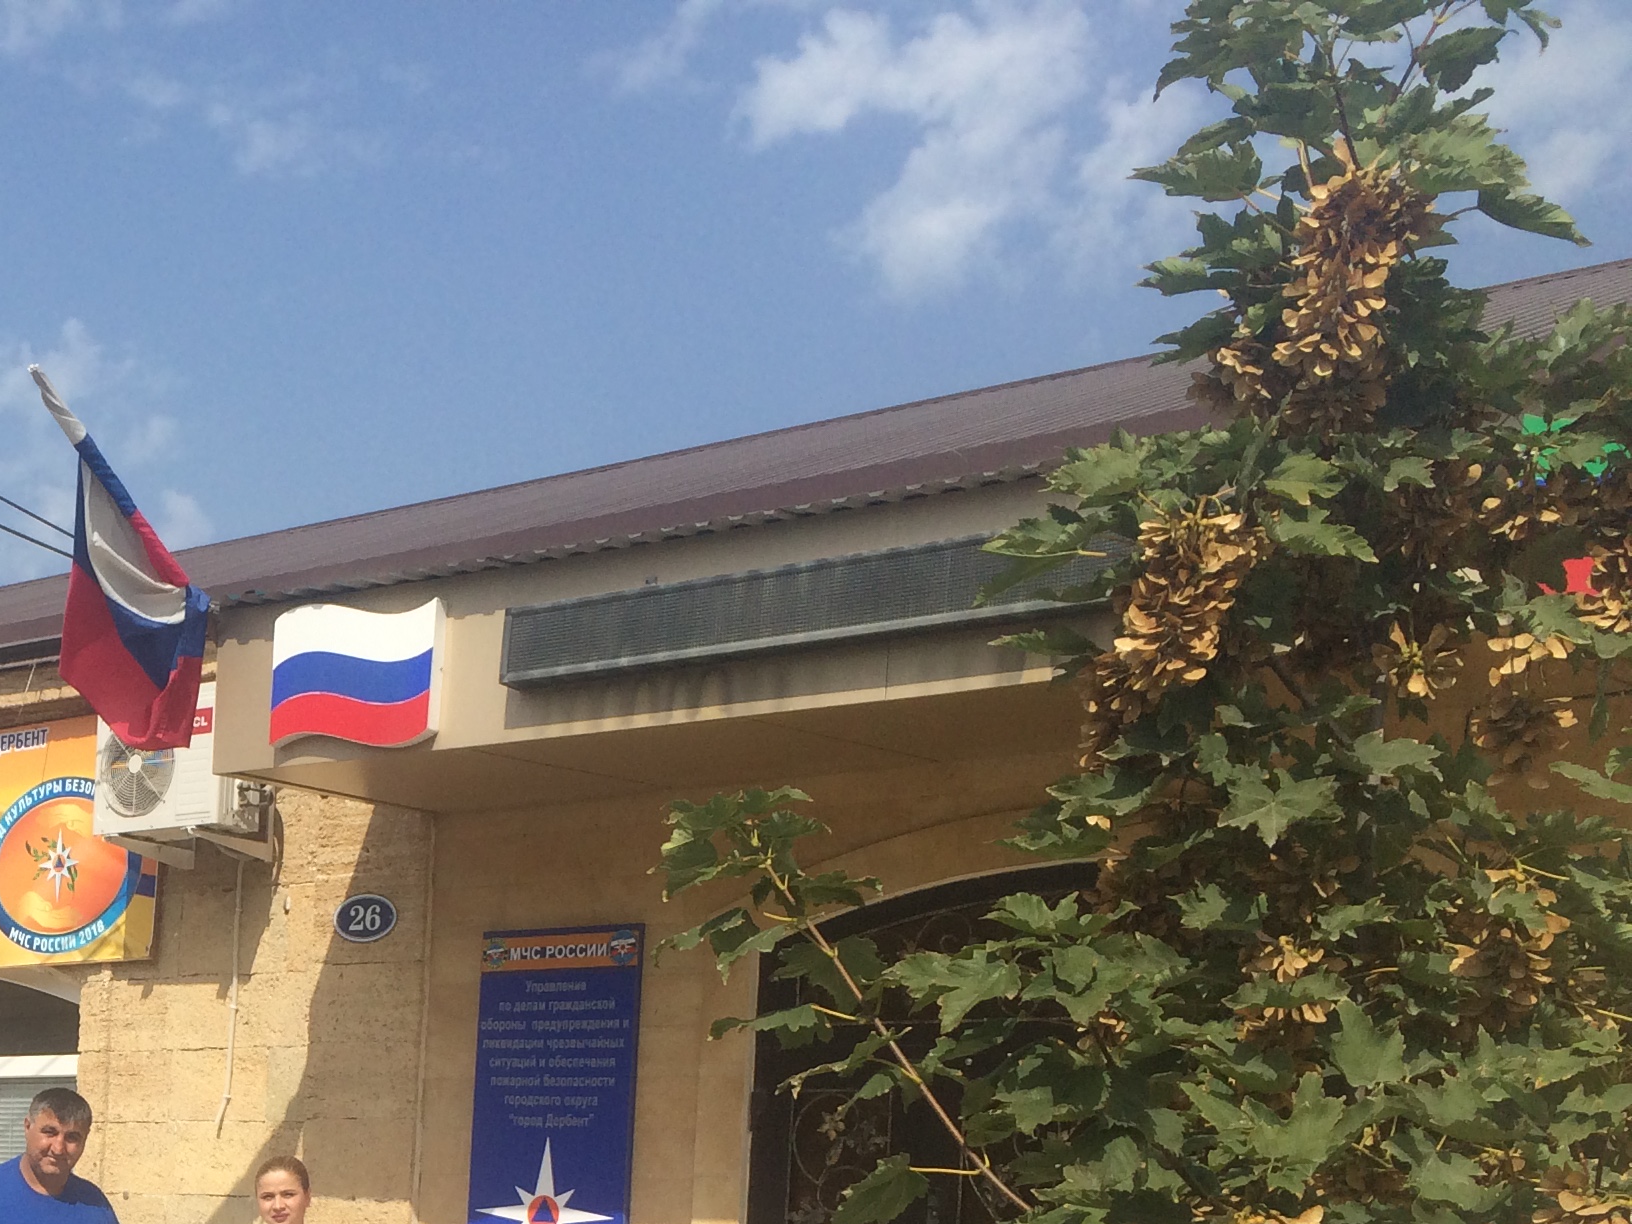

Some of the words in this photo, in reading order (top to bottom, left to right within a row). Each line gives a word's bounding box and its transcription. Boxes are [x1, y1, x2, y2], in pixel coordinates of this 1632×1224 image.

[193, 716, 209, 728] CL
[348, 905, 381, 931] 26
[9, 926, 30, 948] МЧС
[33, 936, 77, 953] РОССИИ
[79, 919, 106, 944] 2018
[510, 946, 542, 961] МЧС
[545, 943, 608, 960] РОССИИ
[525, 980, 587, 995] Управление
[498, 1001, 512, 1012] по
[513, 1001, 546, 1013] делам
[548, 996, 616, 1013] гражданской
[480, 1017, 527, 1033] обороны
[622, 1018, 630, 1029] и
[489, 1055, 537, 1070] ситуаций
[538, 1057, 546, 1068] и
[490, 1074, 541, 1088] пожарной
[543, 1074, 616, 1087] безопасности
[504, 1094, 562, 1108] городского
[563, 1094, 599, 1109] округа
